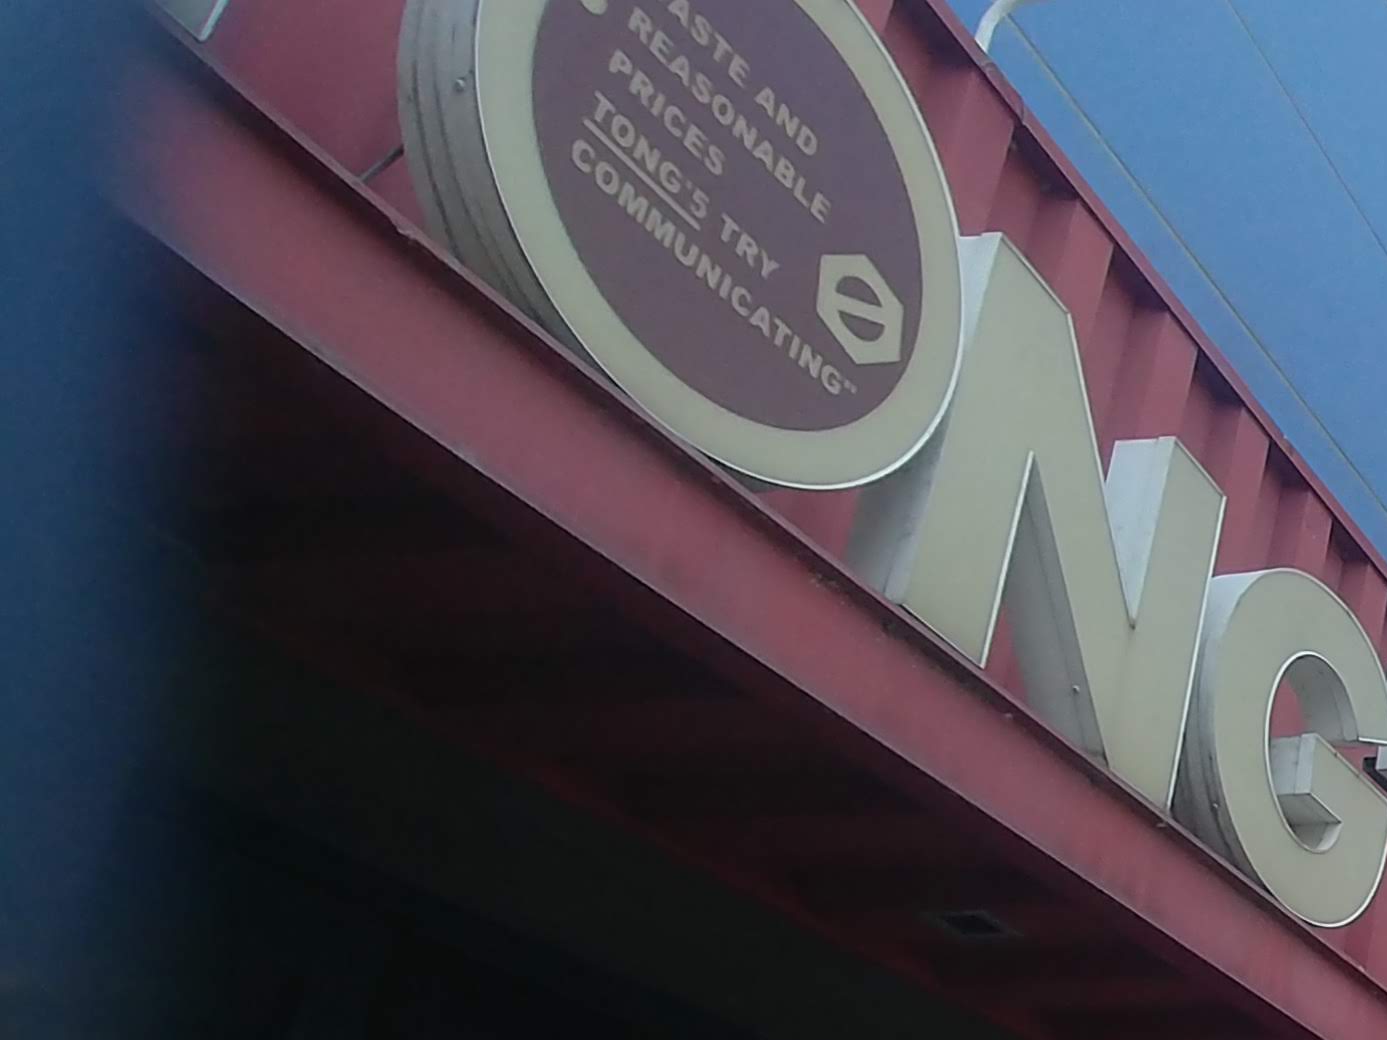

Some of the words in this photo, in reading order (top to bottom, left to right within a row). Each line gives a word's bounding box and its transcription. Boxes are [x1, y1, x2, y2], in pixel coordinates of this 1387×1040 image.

[608, 49, 726, 176] PRICES
[628, 8, 831, 223] REASONABLE
[664, 0, 751, 90] ASTE
[755, 87, 820, 158] AND
[719, 213, 781, 278] TRY
